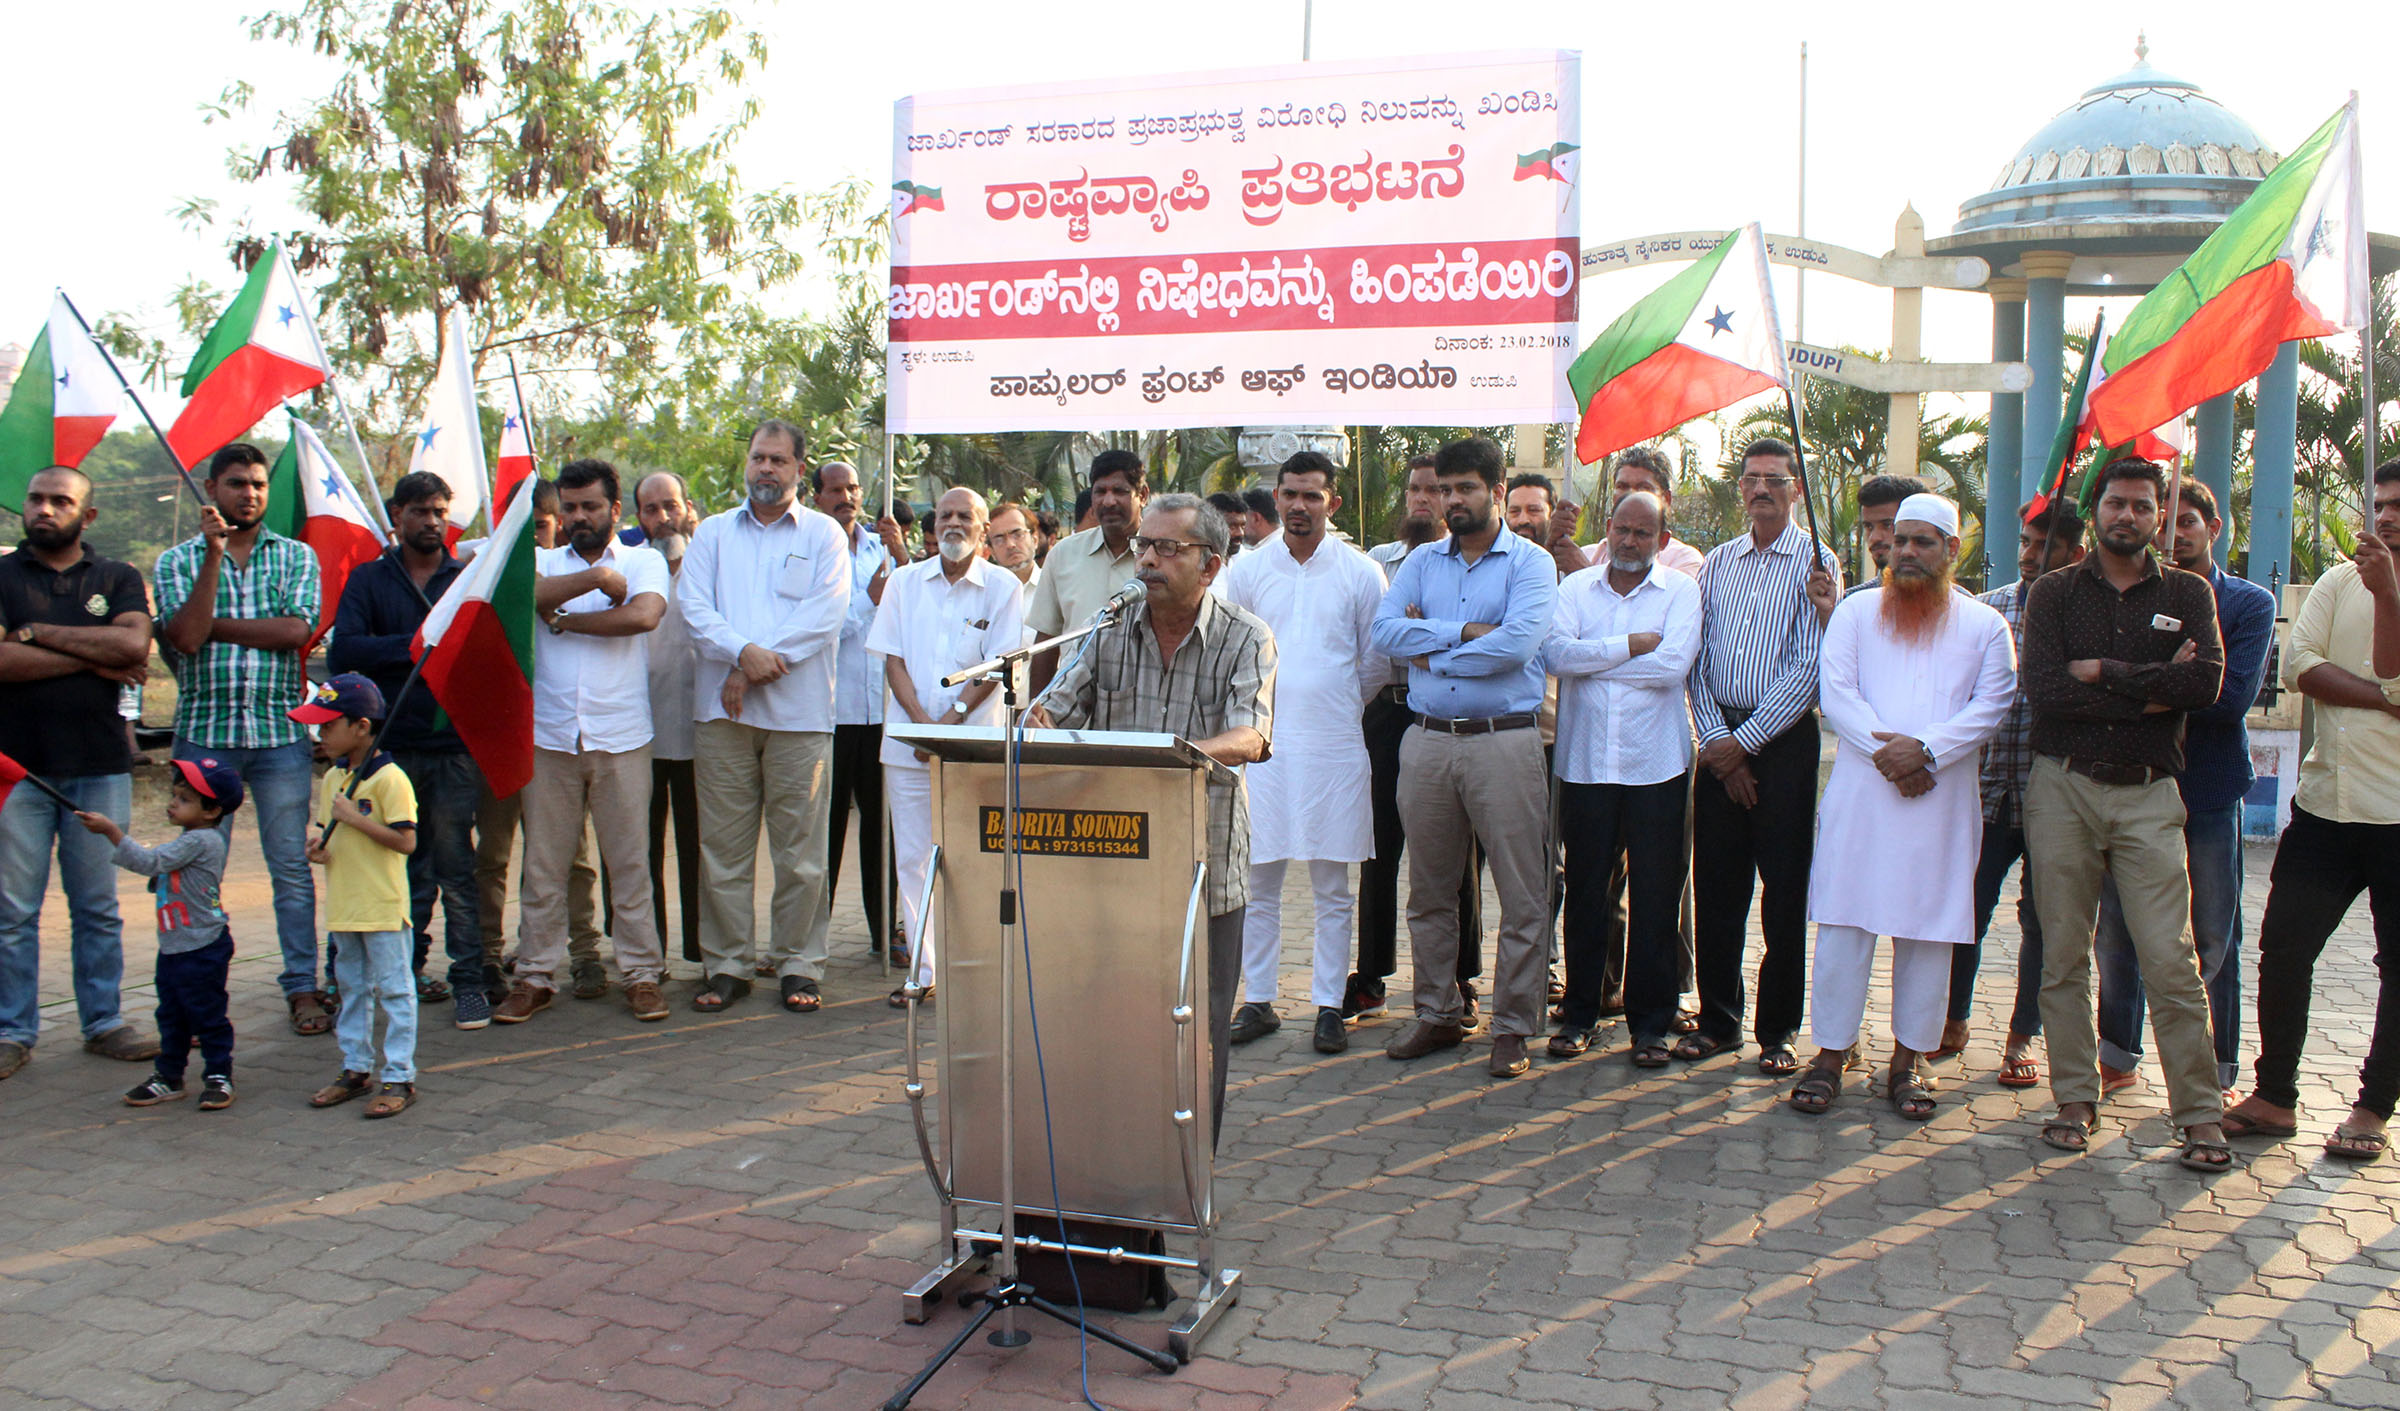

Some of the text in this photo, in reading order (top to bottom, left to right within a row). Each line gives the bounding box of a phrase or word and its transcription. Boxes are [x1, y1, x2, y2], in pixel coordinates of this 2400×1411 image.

[907, 90, 1559, 152] ಜಾರ್ಖಂಡ್ ಸರಕಾರದ ಪ್ರಜಾಪ್ರಭುತ್ವ ವಿರೋಧಿ ನಿಲುವನ್ನು ಖಂಡಿಸಿ
[984, 143, 1466, 243] ರಾಷ್ಟ್ರವ್ಯಾಪಿ ಪ್ರತಿಭಟನೆ
[1635, 238, 1682, 262] ಸೈನಿಕರ
[1784, 244, 1829, 265] ಉಡುಪಿ
[1136, 253, 1335, 324] ನಿಷೇಧವನ್ನು
[1349, 246, 1575, 304] ಹಿಂಪಡೆಯಿರಿ
[1434, 334, 1571, 352] ದಿನಾಂಕ: 23.02.2018
[932, 349, 975, 363] ಉಡುಪಿ
[990, 358, 1518, 407] ಪಾಪ್ಯುಲರ್ ಫ್ರಂಟ್ ಆಫ್ ಇಂಡಿಯಾ ಉಡುಪಿ
[1071, 814, 1142, 840] SOUNDS
[1052, 840, 1140, 855] 9731515344
